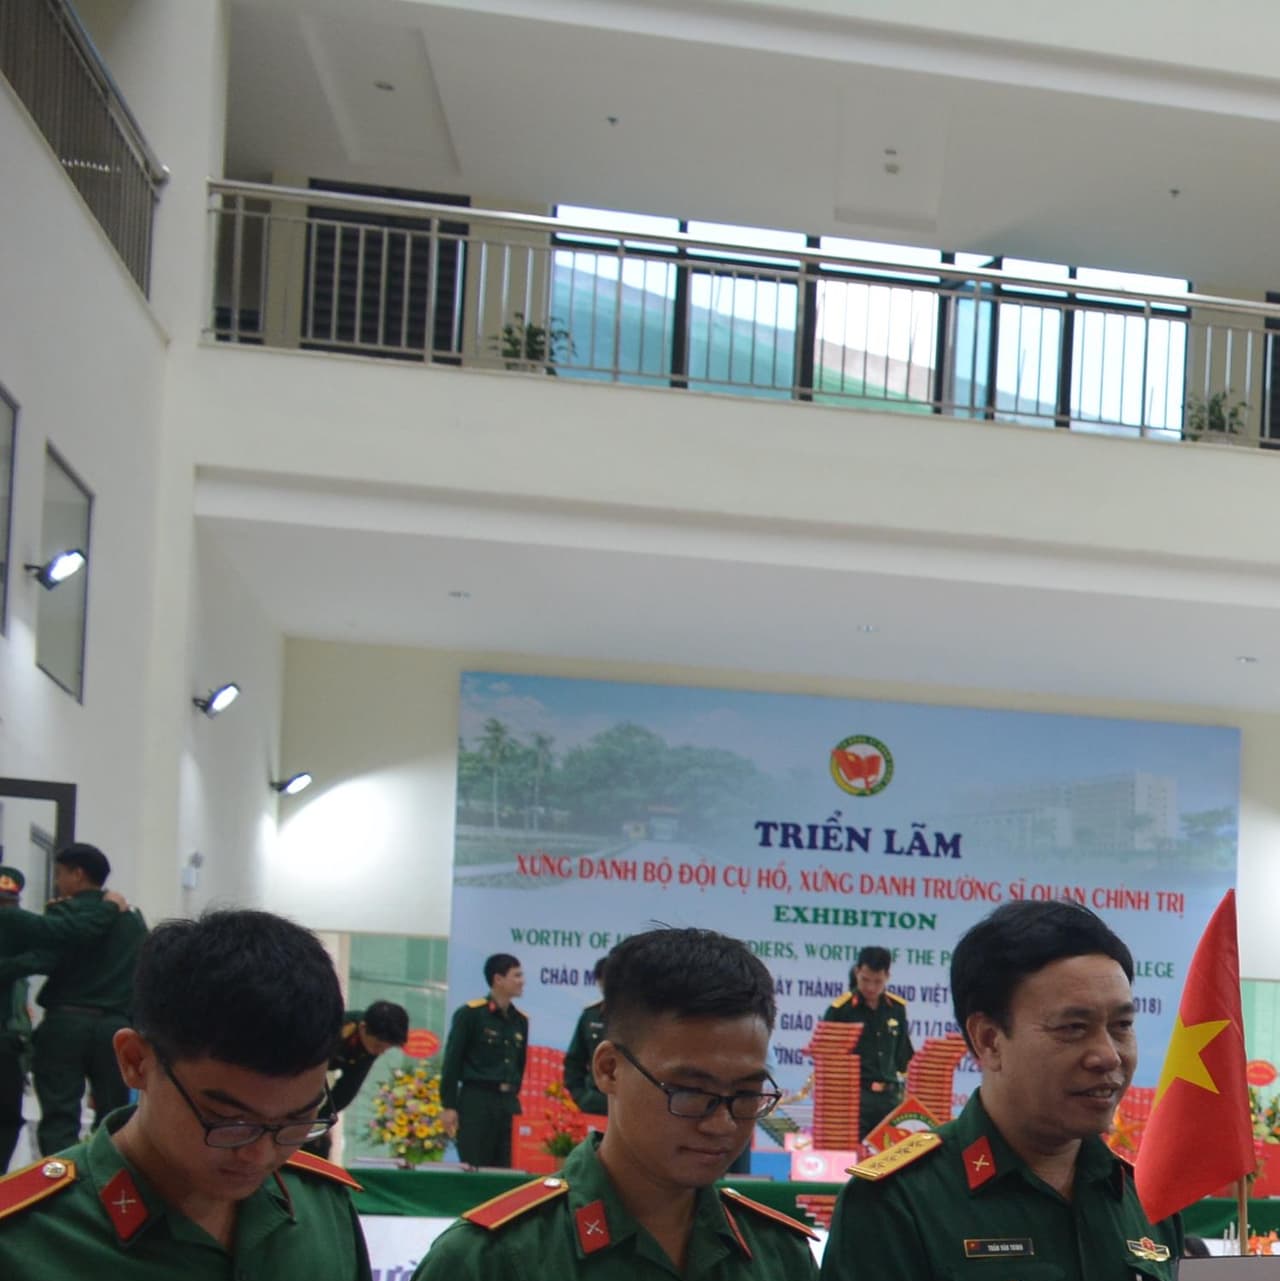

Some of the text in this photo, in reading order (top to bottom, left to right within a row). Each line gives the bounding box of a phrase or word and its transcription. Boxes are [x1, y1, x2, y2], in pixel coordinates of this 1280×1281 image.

[754, 810, 963, 859] TRIỂN LÃM
[578, 854, 637, 882] DANH
[643, 857, 673, 890] BỘ
[679, 859, 716, 892] ĐỘI
[723, 867, 750, 894] CỤ
[860, 873, 916, 898] DANH
[1092, 882, 1149, 911] CHÍNH
[1156, 892, 1186, 919] TRỊ
[774, 904, 937, 931] EXHIBITION
[511, 928, 582, 948] WORTHY
[589, 931, 611, 949] OF
[748, 940, 798, 961] DIERS,
[804, 942, 860, 963] WORTH
[907, 949, 936, 965] THE
[540, 963, 579, 986] CHÀO
[798, 977, 843, 999] THÀNH
